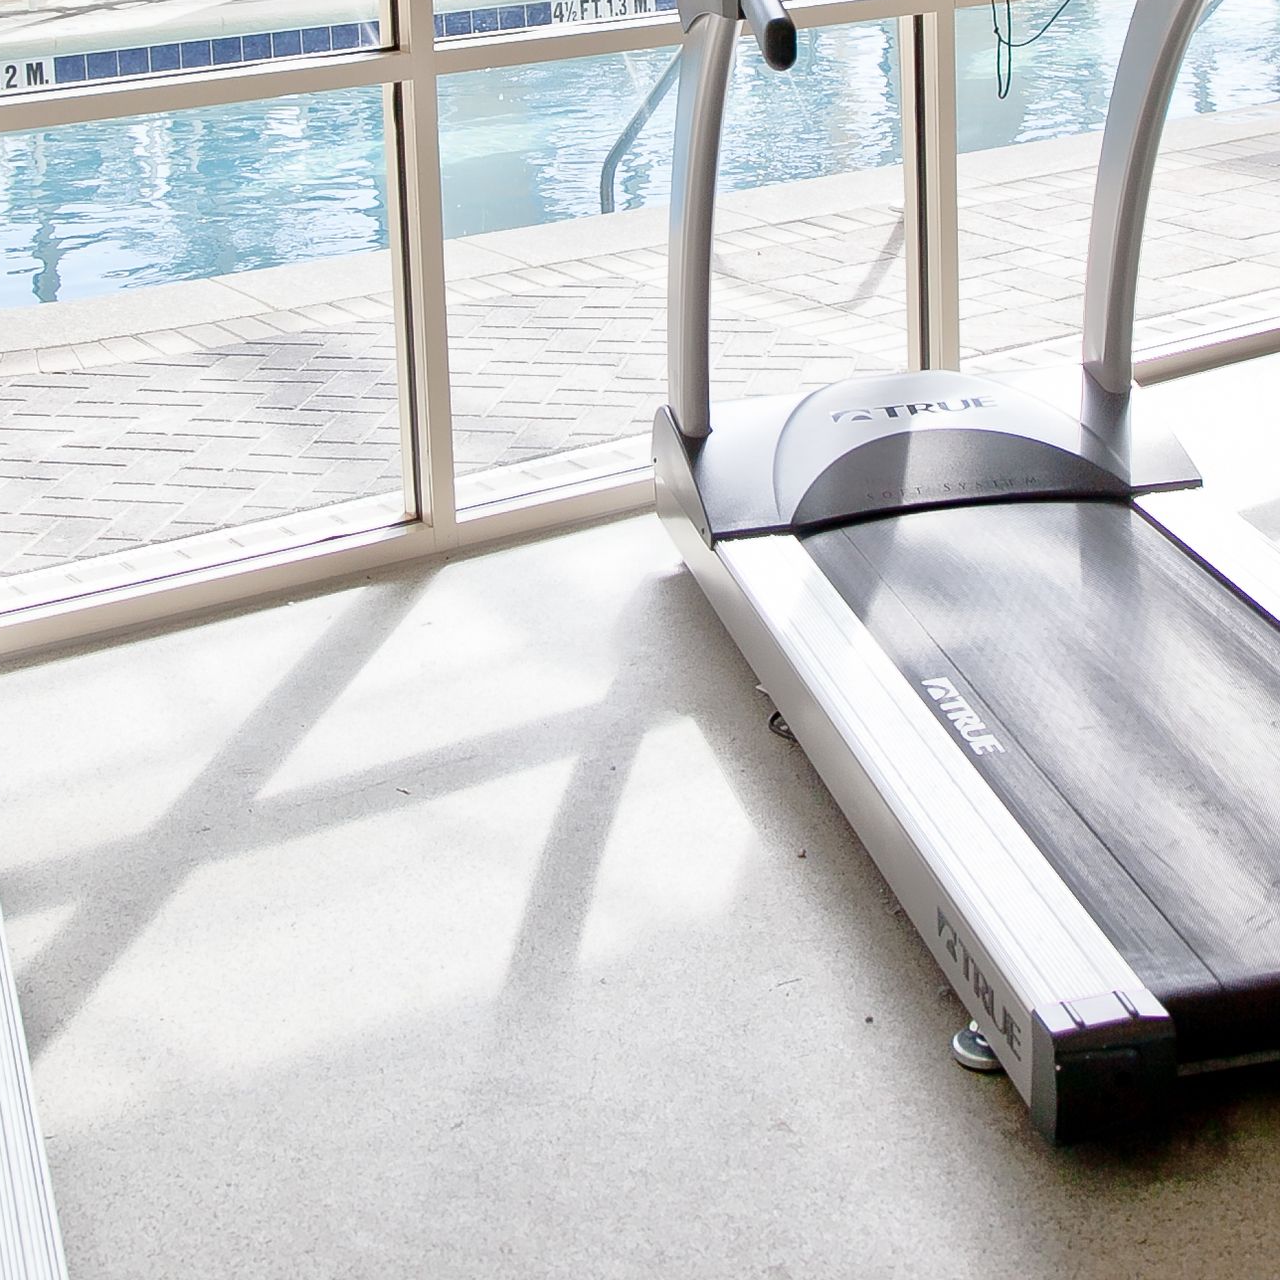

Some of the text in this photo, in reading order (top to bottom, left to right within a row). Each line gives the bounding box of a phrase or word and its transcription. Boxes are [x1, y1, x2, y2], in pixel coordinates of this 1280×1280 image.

[25, 61, 50, 86] M.
[873, 395, 999, 419] TRUE
[867, 474, 1040, 501] SOFT SYSTEM
[939, 695, 1006, 756] TRUE
[957, 937, 1022, 1063] TRUE
